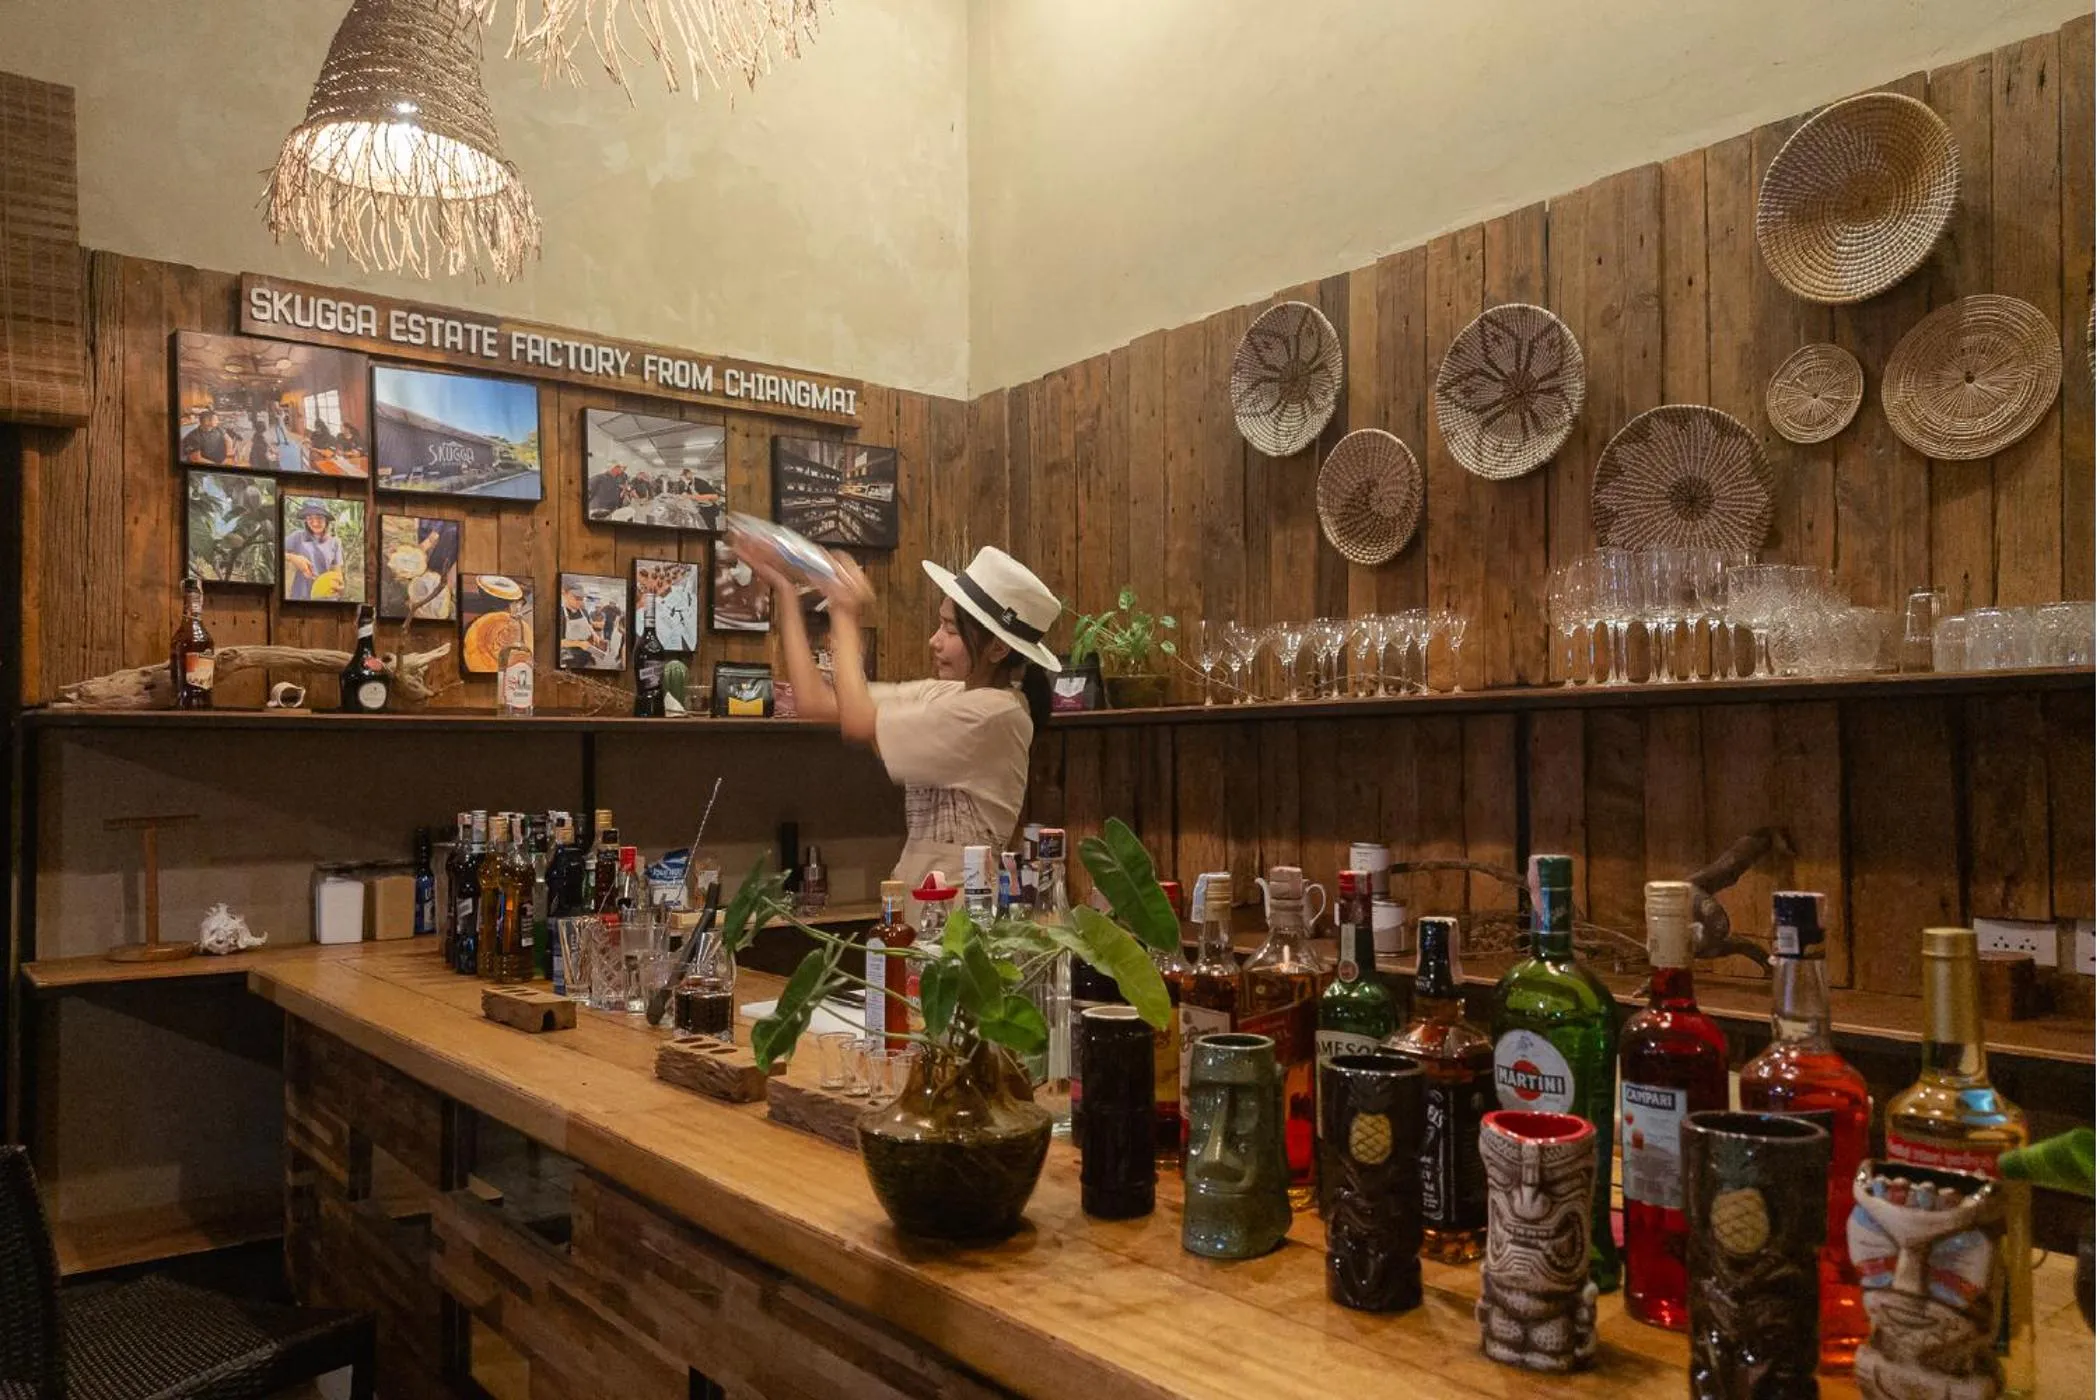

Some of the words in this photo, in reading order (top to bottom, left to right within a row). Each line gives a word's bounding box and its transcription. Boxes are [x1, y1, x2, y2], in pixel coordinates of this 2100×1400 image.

[250, 287, 377, 338] SKUGGA
[389, 309, 499, 358] ESTATE
[511, 331, 630, 377] FACTORY
[643, 354, 714, 394] FROM
[724, 368, 857, 416] CHIANGMAI
[1498, 1067, 1564, 1094] MARTINI
[1626, 1086, 1675, 1109] CAMPARI
